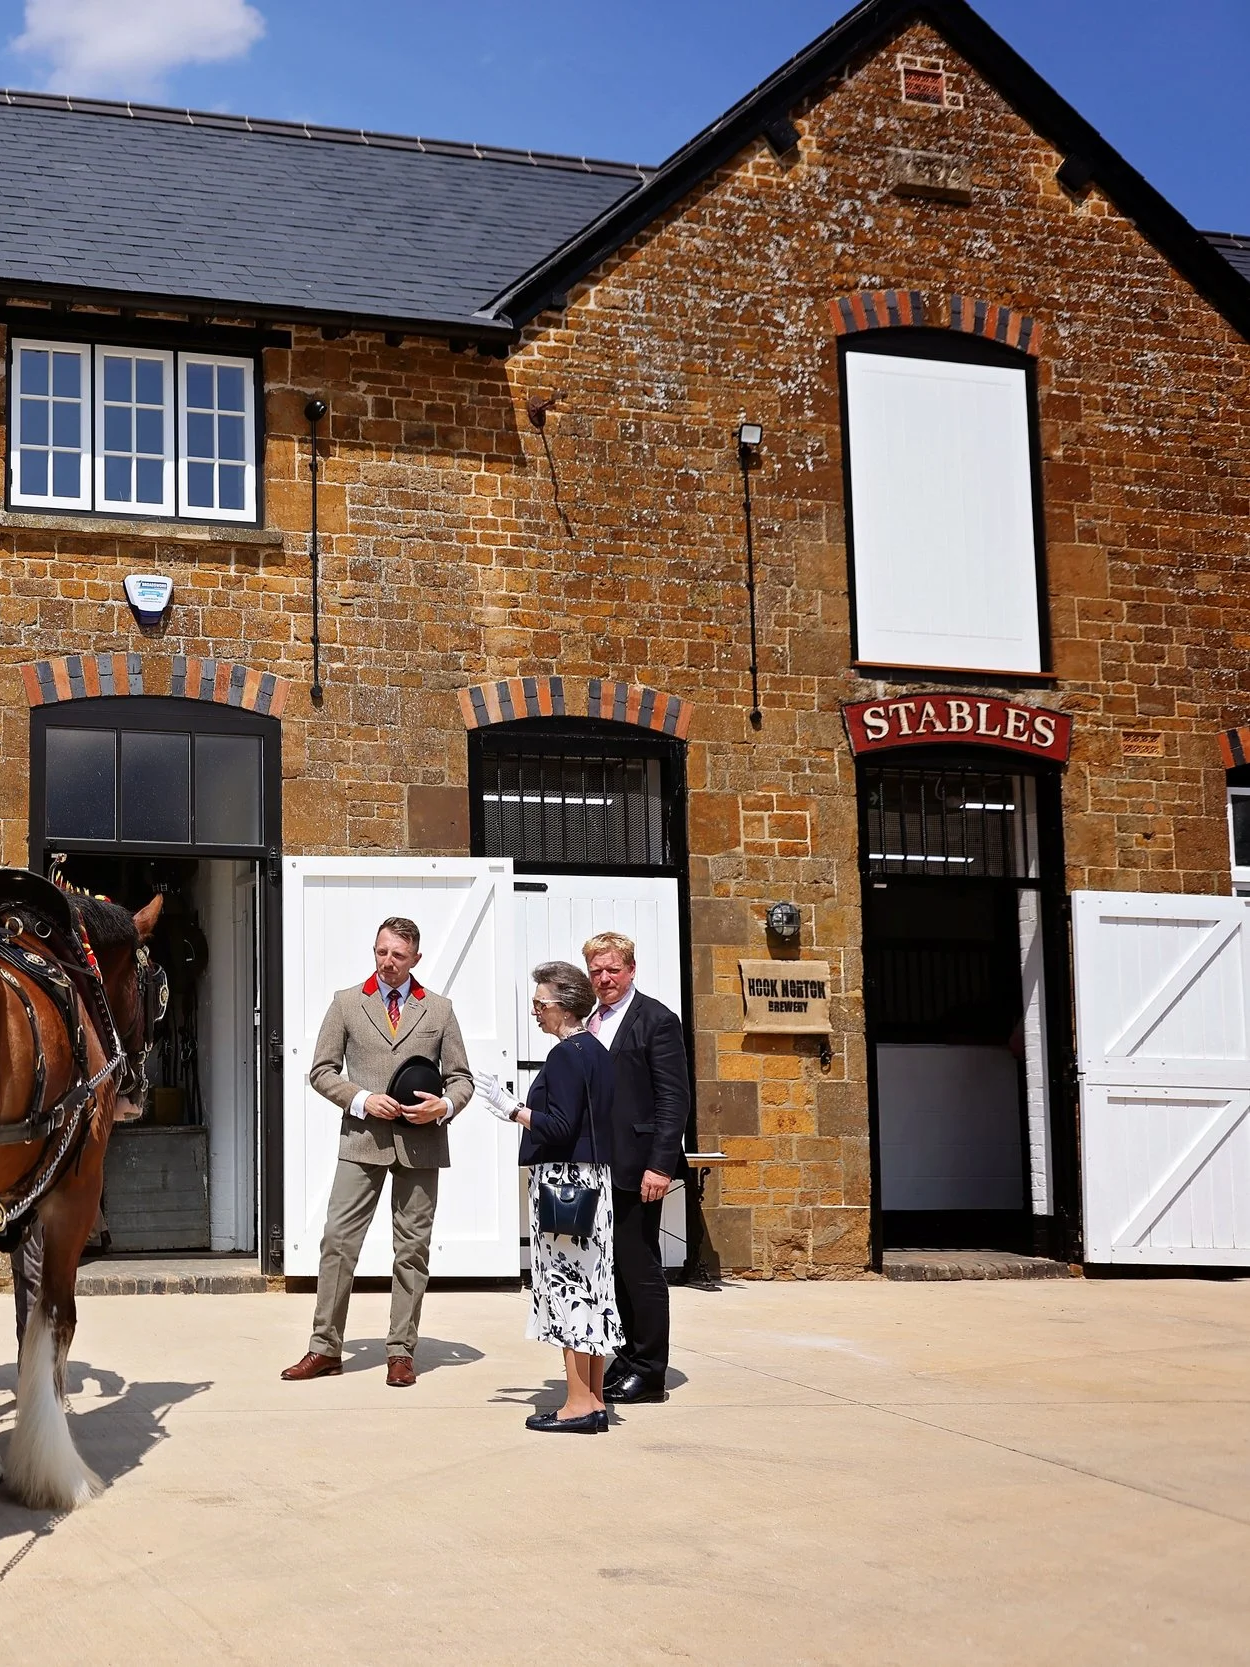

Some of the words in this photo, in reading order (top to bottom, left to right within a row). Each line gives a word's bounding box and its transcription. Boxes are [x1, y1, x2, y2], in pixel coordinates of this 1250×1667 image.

[862, 700, 1056, 748] STABLES
[748, 978, 778, 998] HOOK
[781, 979, 826, 999] NORTON
[768, 1001, 808, 1013] BREWERY
